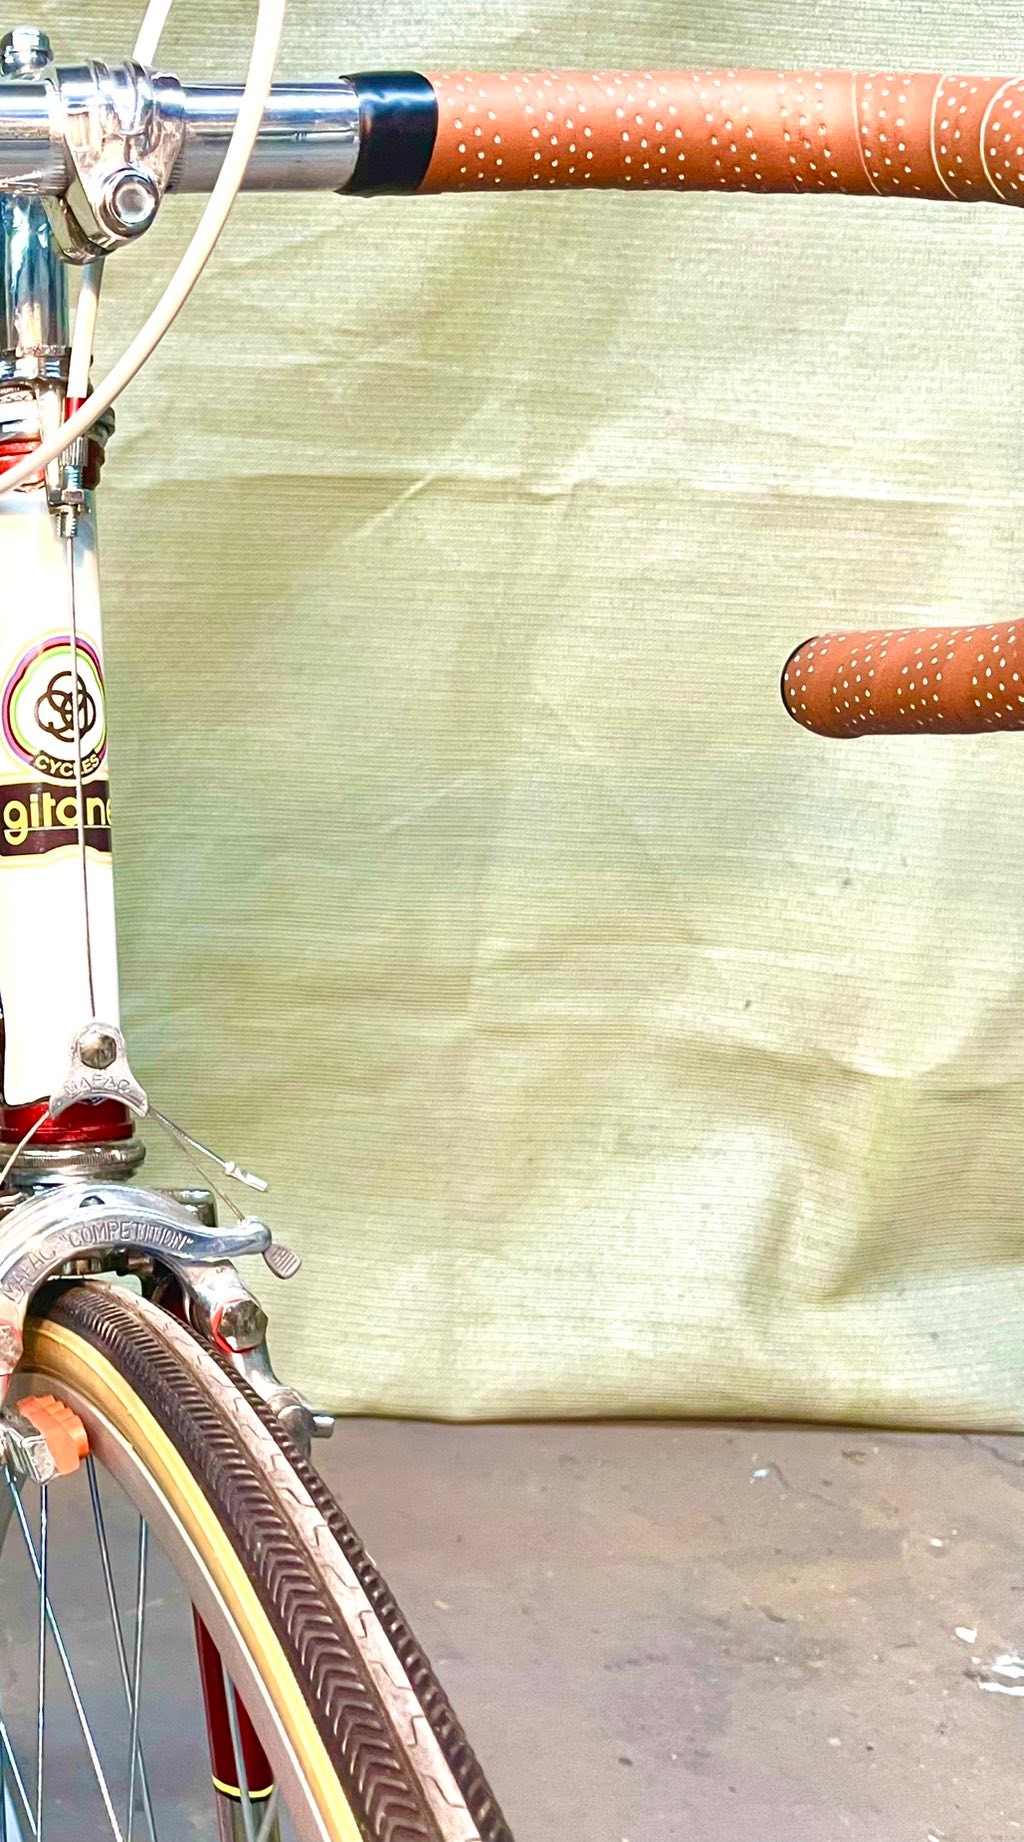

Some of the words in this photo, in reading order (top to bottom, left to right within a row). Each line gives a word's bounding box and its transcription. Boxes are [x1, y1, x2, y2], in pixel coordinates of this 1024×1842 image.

[3, 791, 112, 846] gitan
[63, 1073, 131, 1097] MAFAC
[0, 1246, 57, 1305] MAFAC
